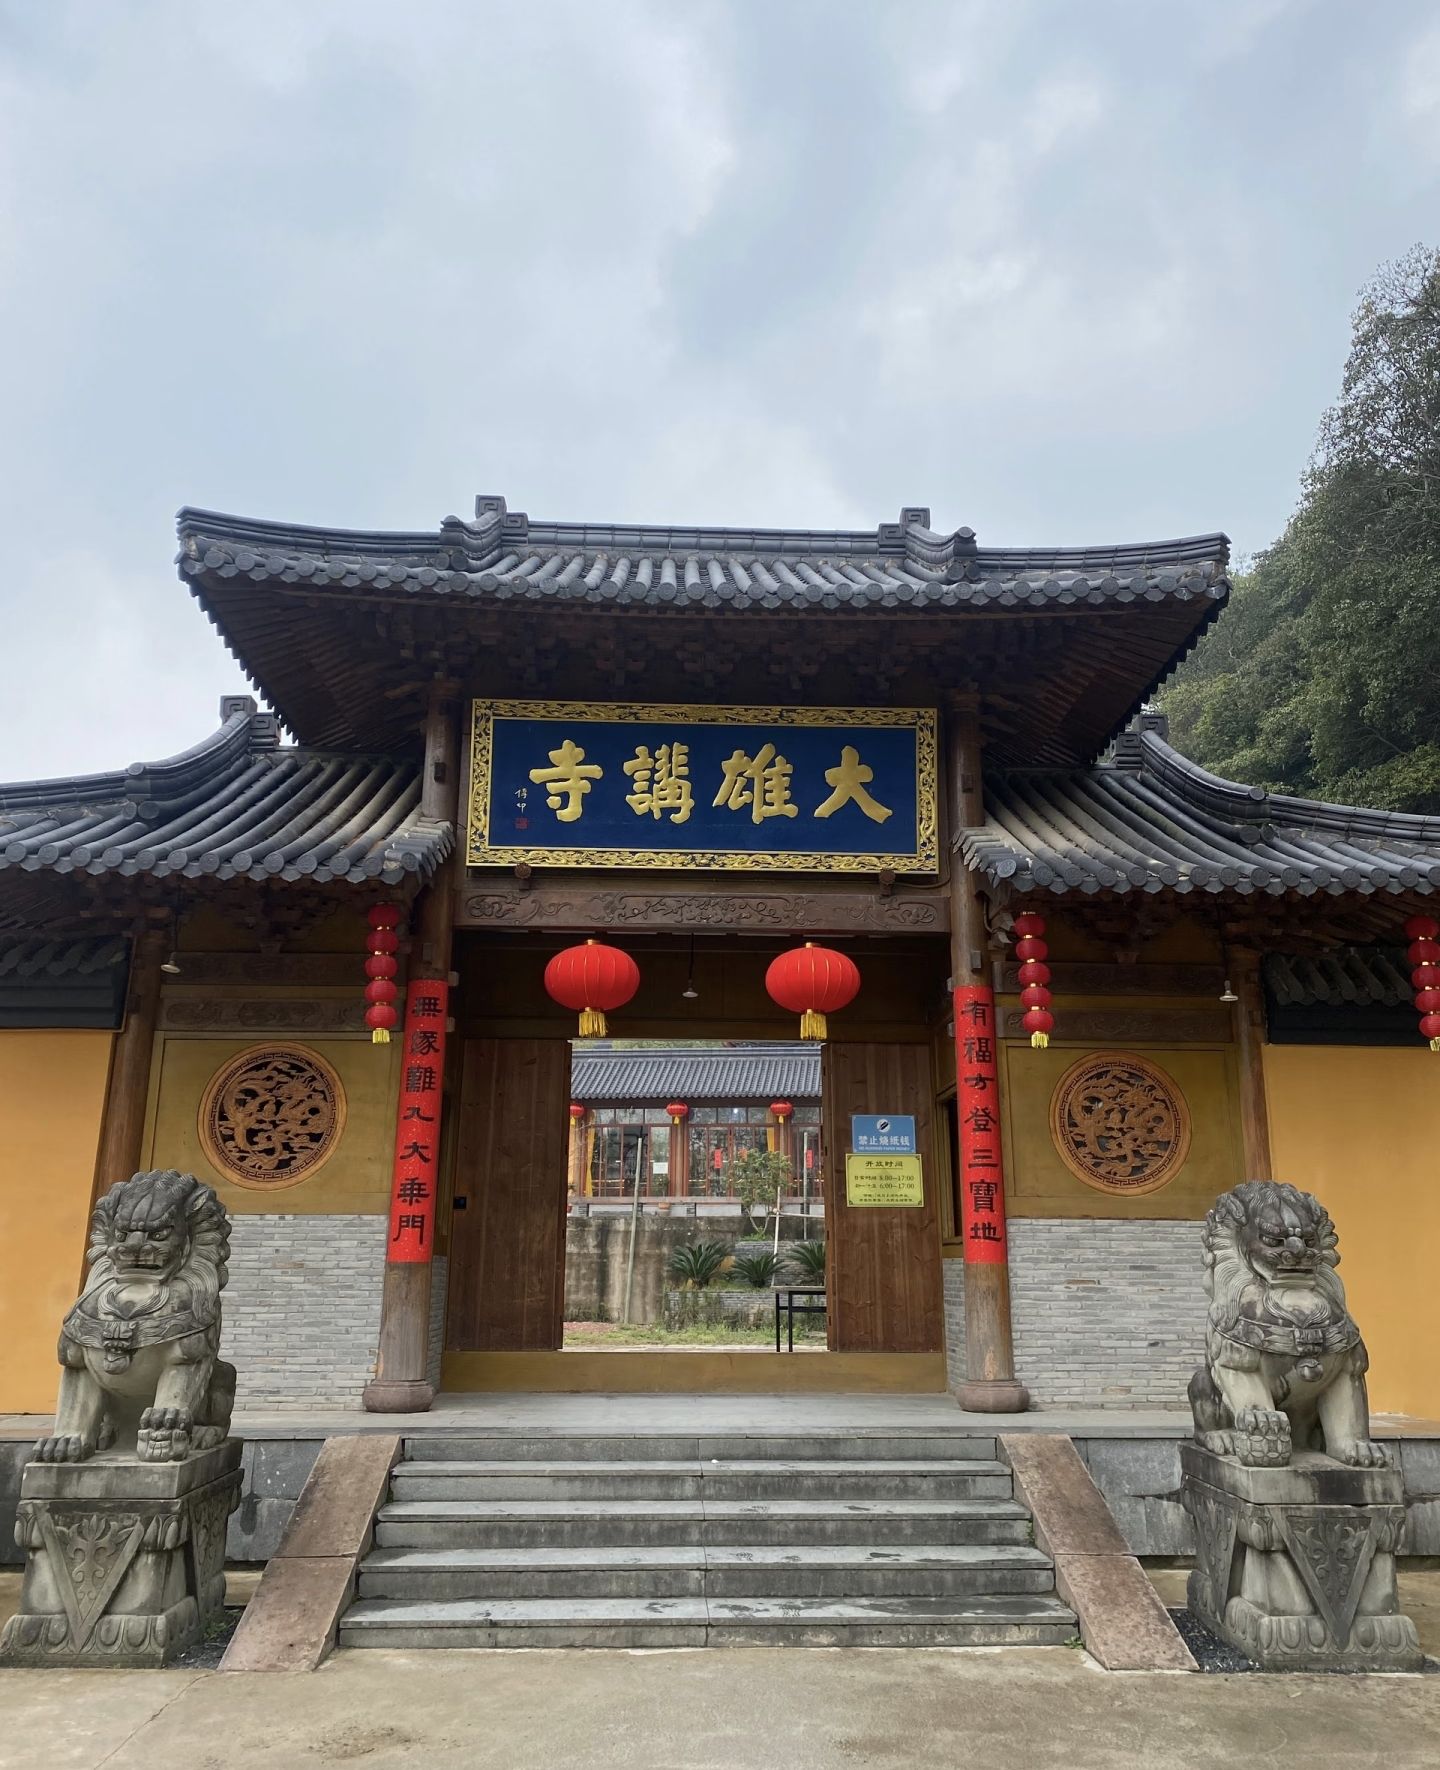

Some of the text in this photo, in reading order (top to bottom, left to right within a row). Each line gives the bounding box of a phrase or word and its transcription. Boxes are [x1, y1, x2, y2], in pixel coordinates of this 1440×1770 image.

[528, 739, 893, 825] 大雄講寺
[858, 1135, 910, 1146] 禁止烧纸钱
